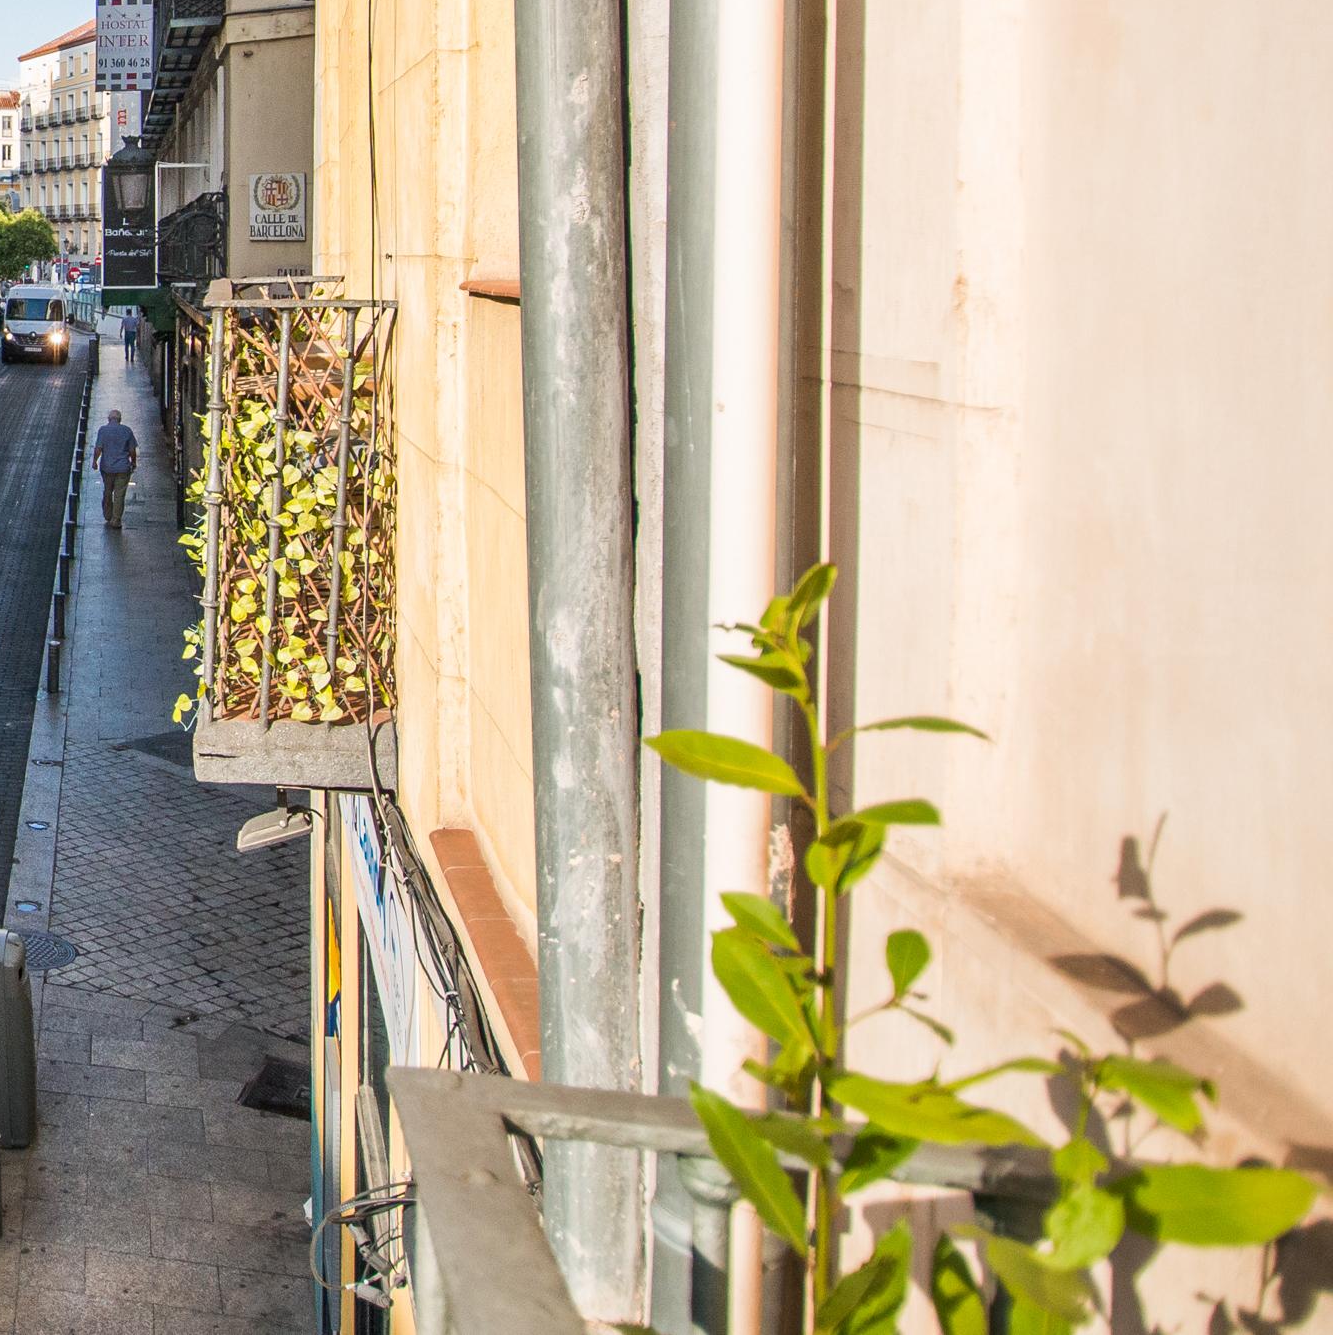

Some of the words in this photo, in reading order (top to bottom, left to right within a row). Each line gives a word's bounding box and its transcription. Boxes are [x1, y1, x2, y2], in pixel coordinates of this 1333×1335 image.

[101, 20, 148, 30] HOSTAL
[98, 34, 149, 48] INTER
[98, 58, 108, 68] 91
[110, 57, 126, 68] 360
[127, 57, 138, 68] 46
[140, 57, 150, 68] 28
[255, 213, 286, 224] CALLE
[288, 214, 299, 223] DE
[250, 225, 304, 238] BARCELONA
